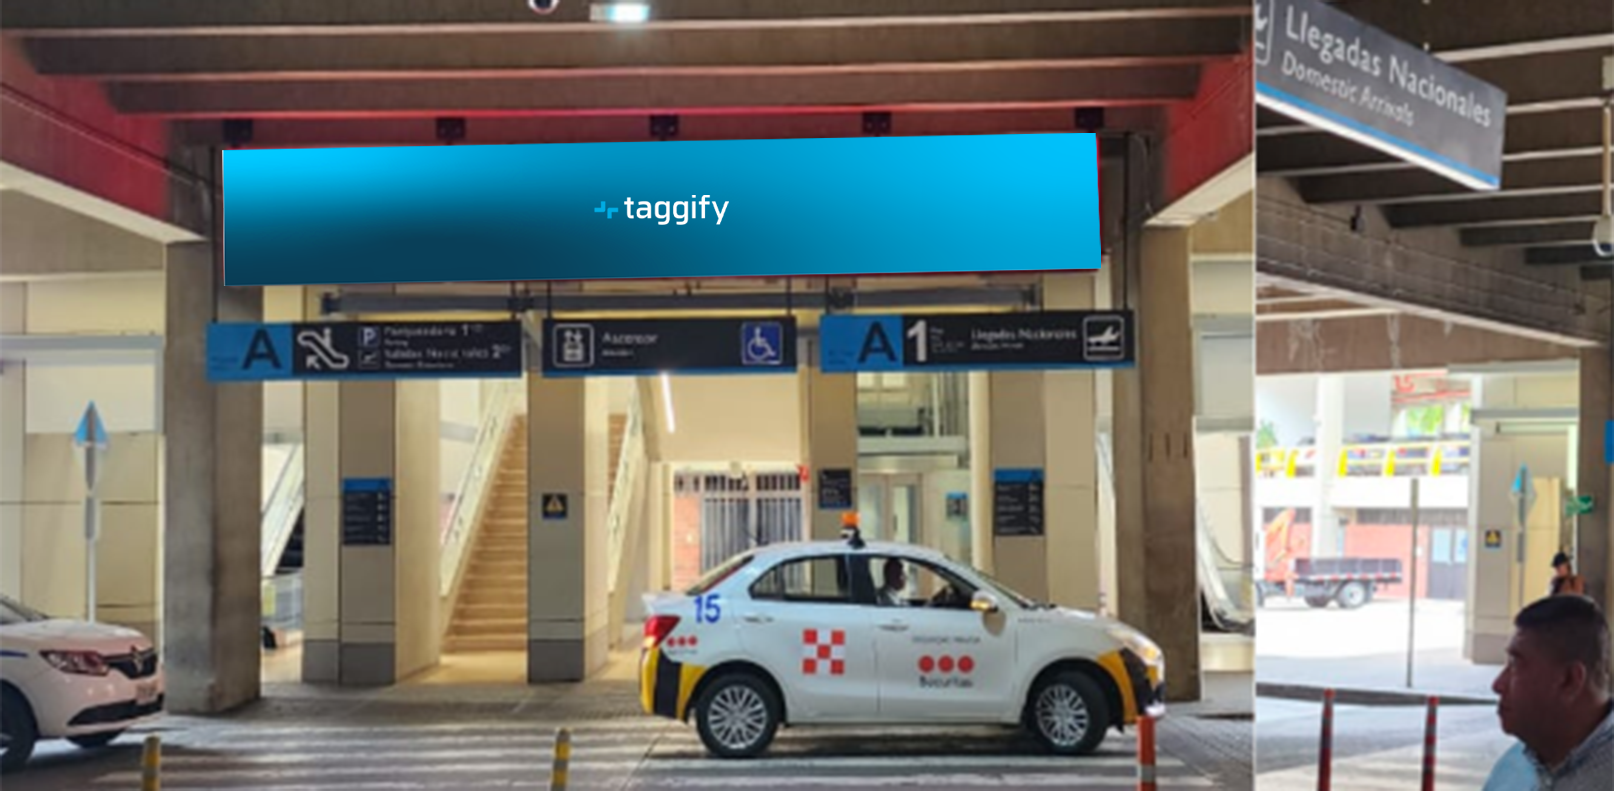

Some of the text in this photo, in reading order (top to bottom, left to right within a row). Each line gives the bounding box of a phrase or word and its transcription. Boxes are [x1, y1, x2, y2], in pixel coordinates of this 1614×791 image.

[1281, 50, 1358, 105] Domestic
[1285, 5, 1491, 129] Llegadas Nacionales
[623, 194, 730, 226] taggify
[241, 327, 284, 371] A
[857, 319, 900, 365] A
[906, 318, 928, 363] 1
[693, 593, 721, 625] 15
